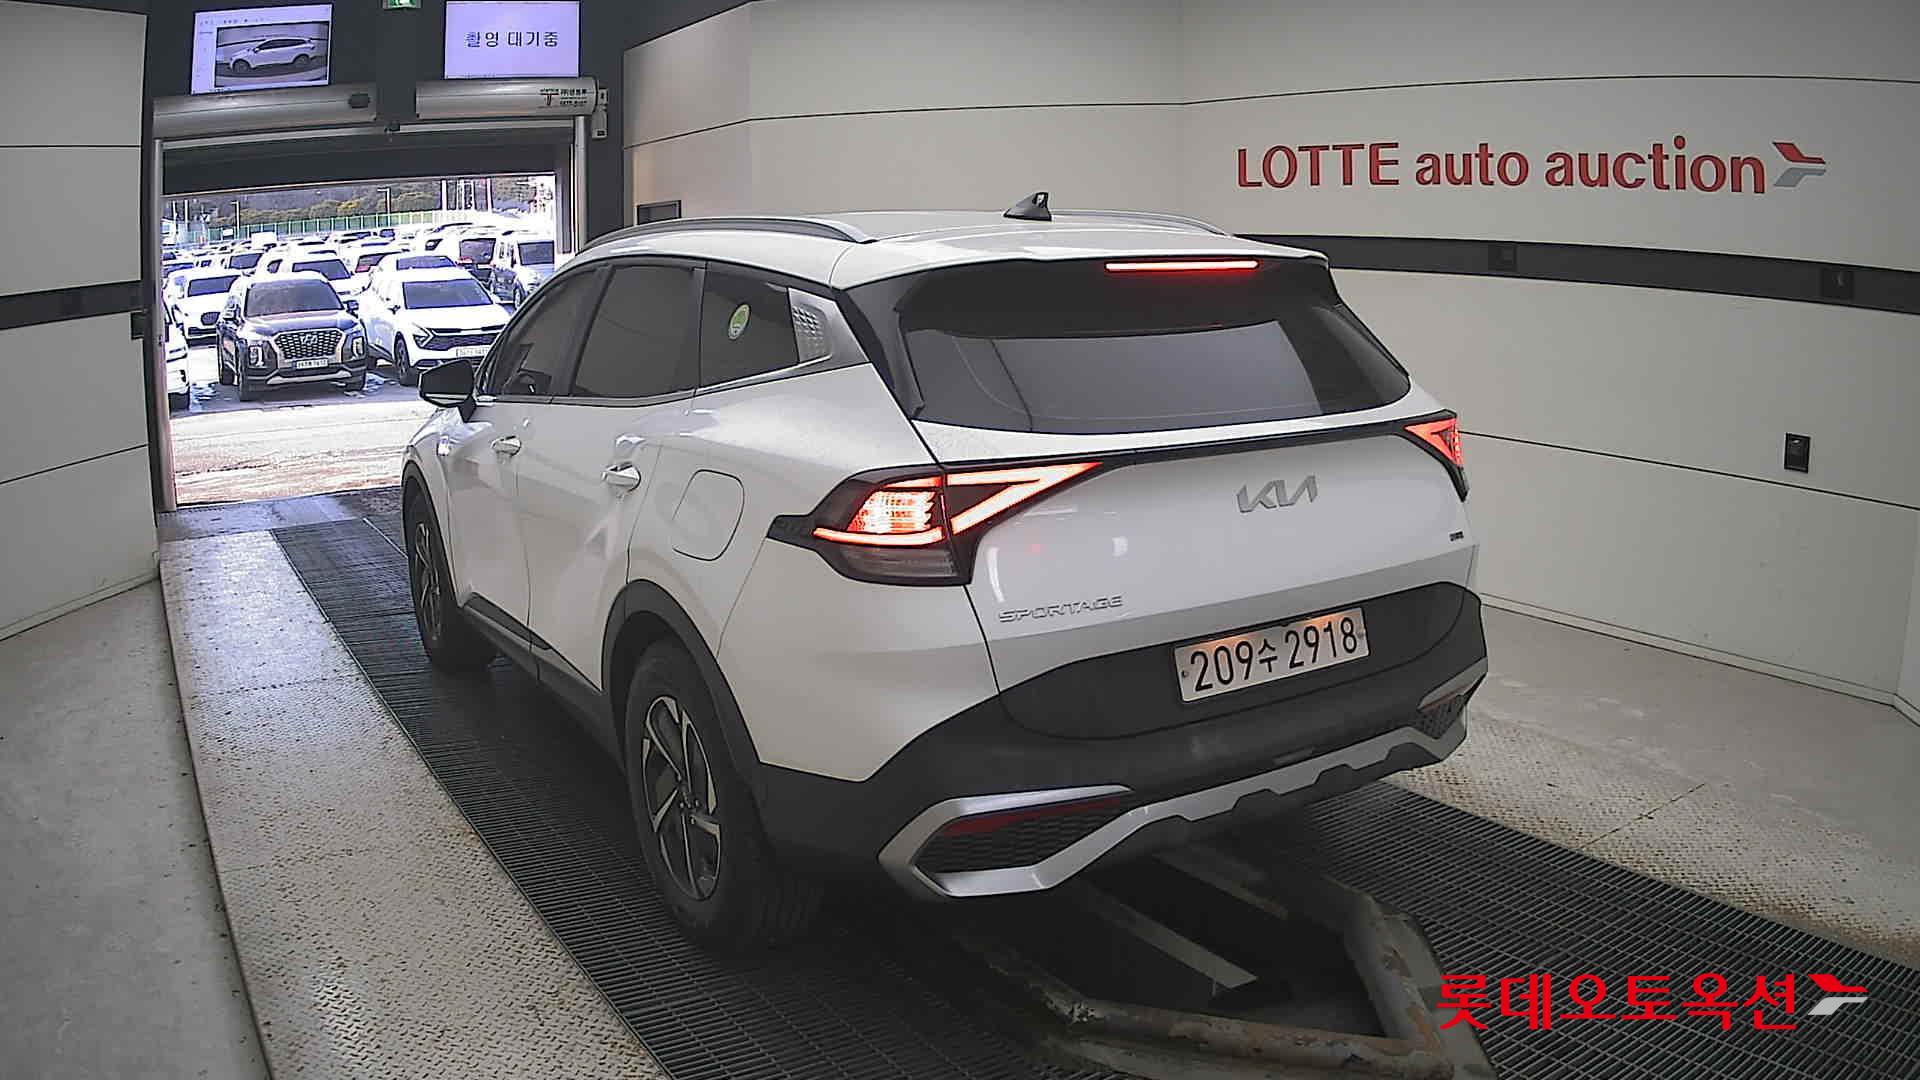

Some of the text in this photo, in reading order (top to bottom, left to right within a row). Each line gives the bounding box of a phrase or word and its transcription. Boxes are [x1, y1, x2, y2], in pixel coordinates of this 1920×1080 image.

[507, 31, 558, 48] 대기중
[1237, 135, 1766, 195] LOTTE auto auction
[1236, 475, 1318, 513] KIA
[999, 595, 1123, 623] SPORTAGE
